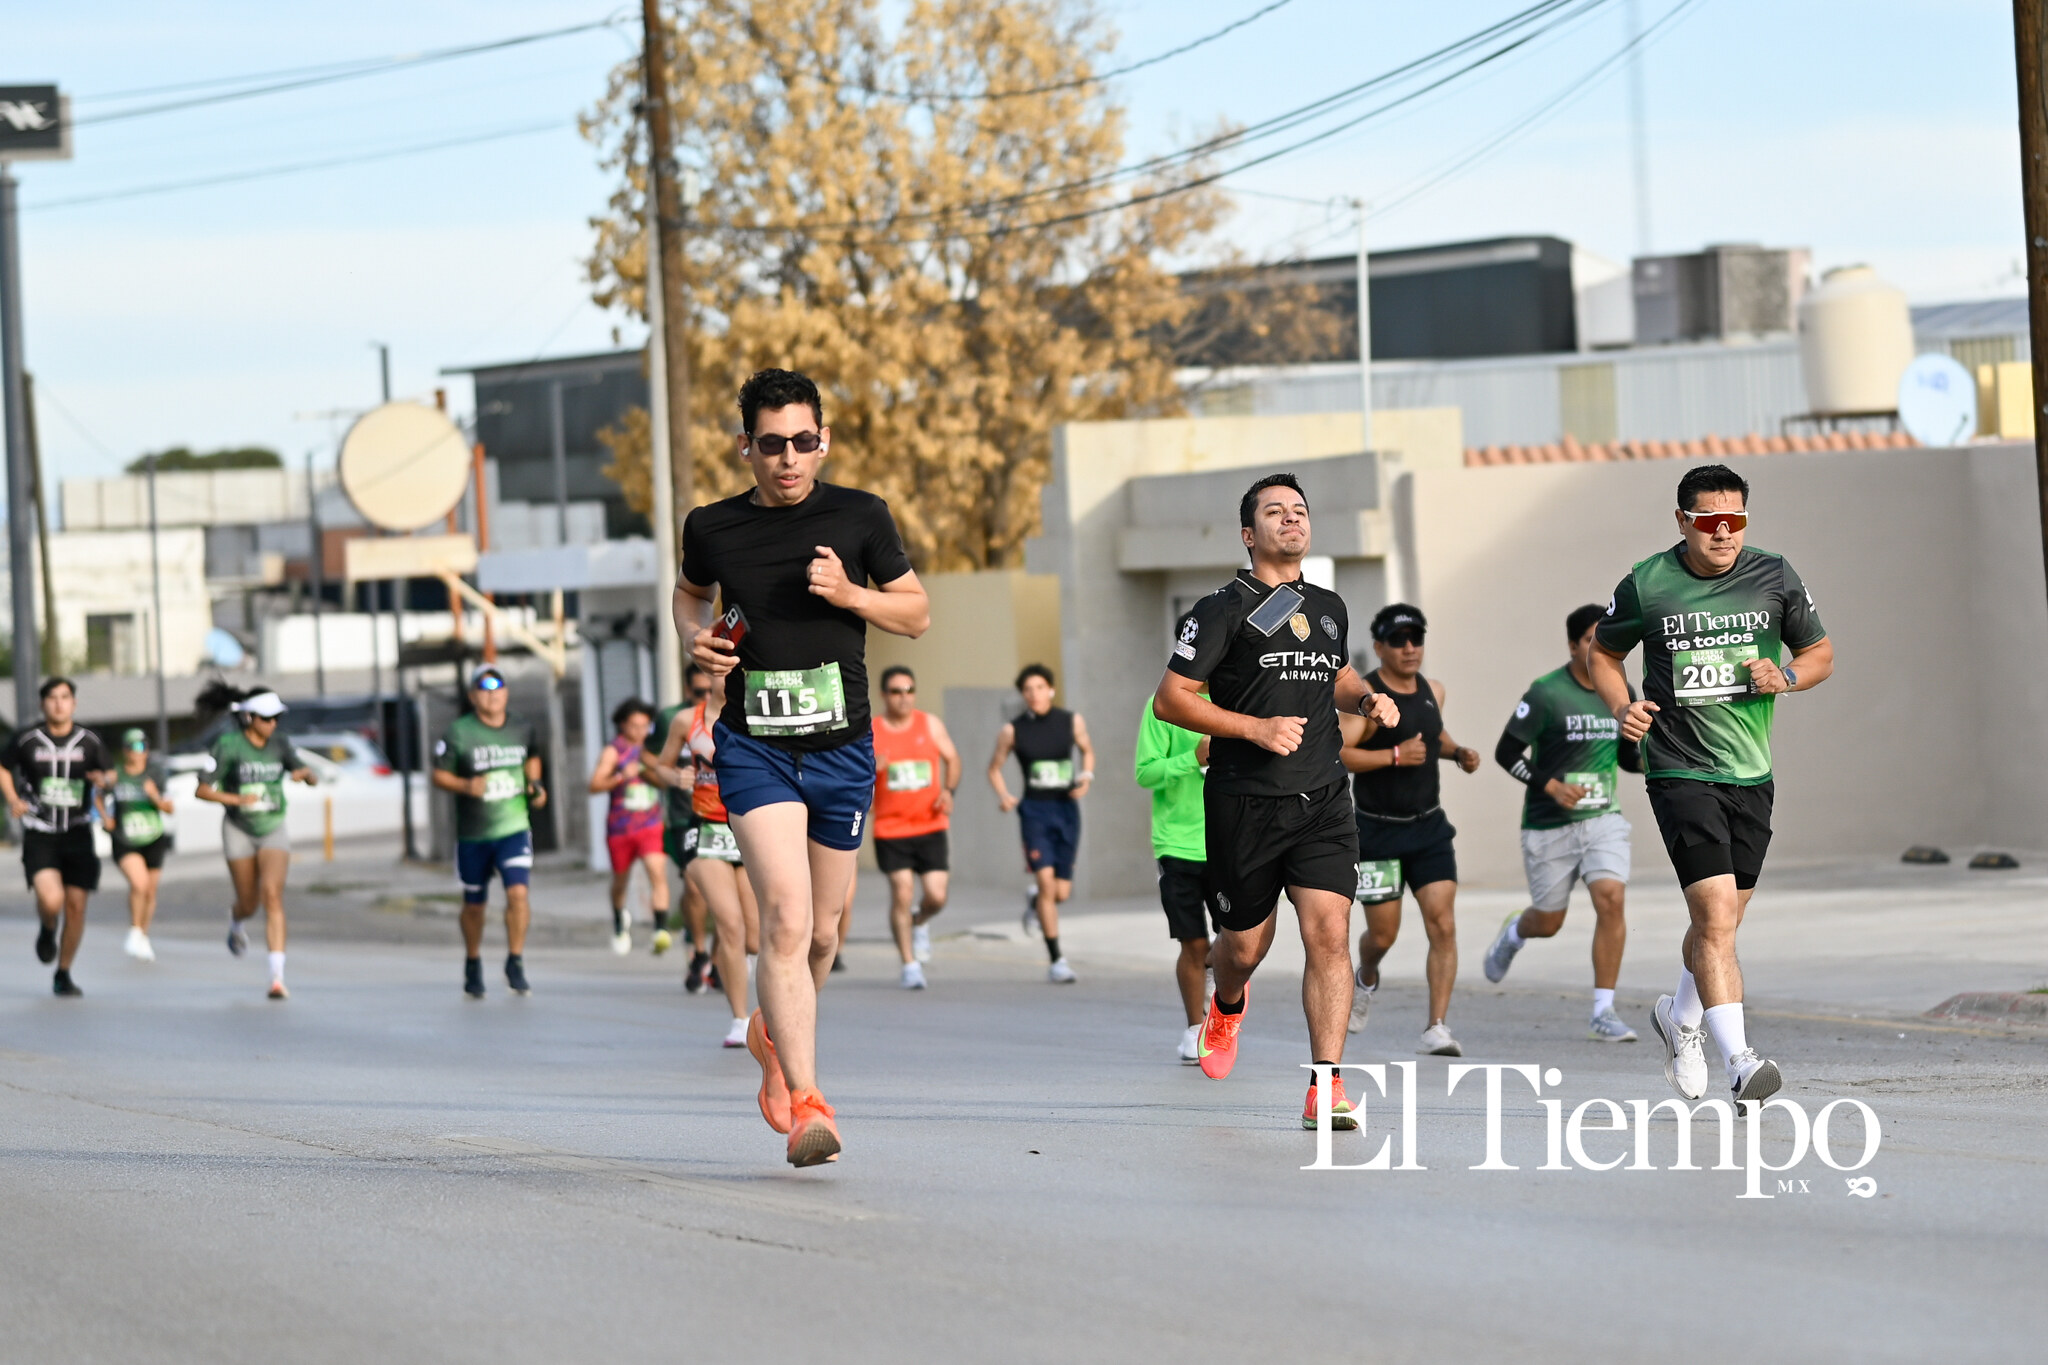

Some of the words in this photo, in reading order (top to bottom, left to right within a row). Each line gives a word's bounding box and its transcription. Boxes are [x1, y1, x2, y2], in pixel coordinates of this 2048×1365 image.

[1661, 614, 1686, 636] El
[1688, 610, 1770, 632] Tiempo
[1665, 638, 1691, 650] de
[1693, 632, 1754, 646] todos
[1259, 651, 1342, 670] ETIHAD
[1279, 670, 1329, 682] AIRWAYS
[1682, 663, 1736, 689] 208
[757, 688, 818, 716] 115
[830, 678, 844, 722] MEDALLA
[1566, 716, 1582, 730] El
[1583, 714, 1618, 731] Tiemp
[1567, 732, 1583, 742] de
[1585, 730, 1617, 741] todos
